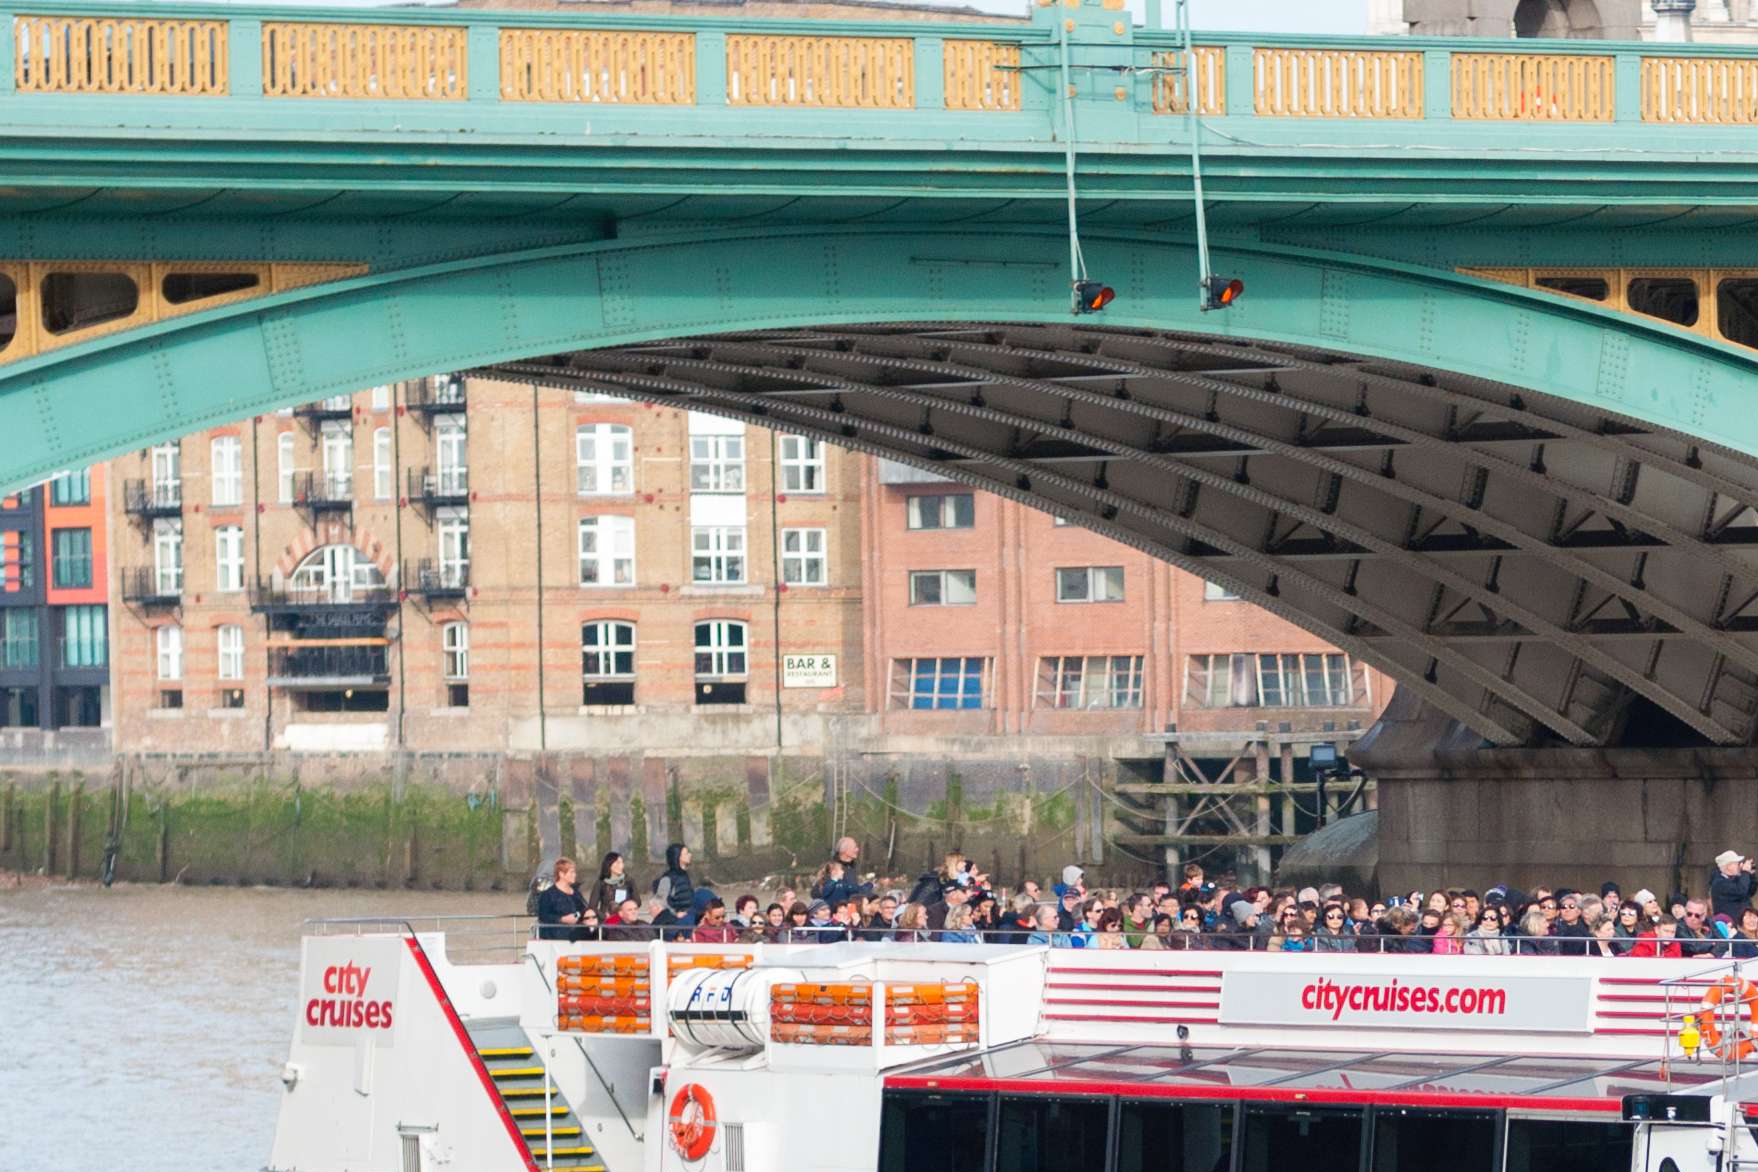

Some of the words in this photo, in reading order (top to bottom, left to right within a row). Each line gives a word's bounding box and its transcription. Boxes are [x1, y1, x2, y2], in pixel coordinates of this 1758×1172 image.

[786, 657, 815, 670] BAR
[820, 657, 831, 669] &
[323, 959, 372, 998] city
[305, 998, 393, 1029] cruises
[1301, 976, 1506, 1021] citycruises.com
